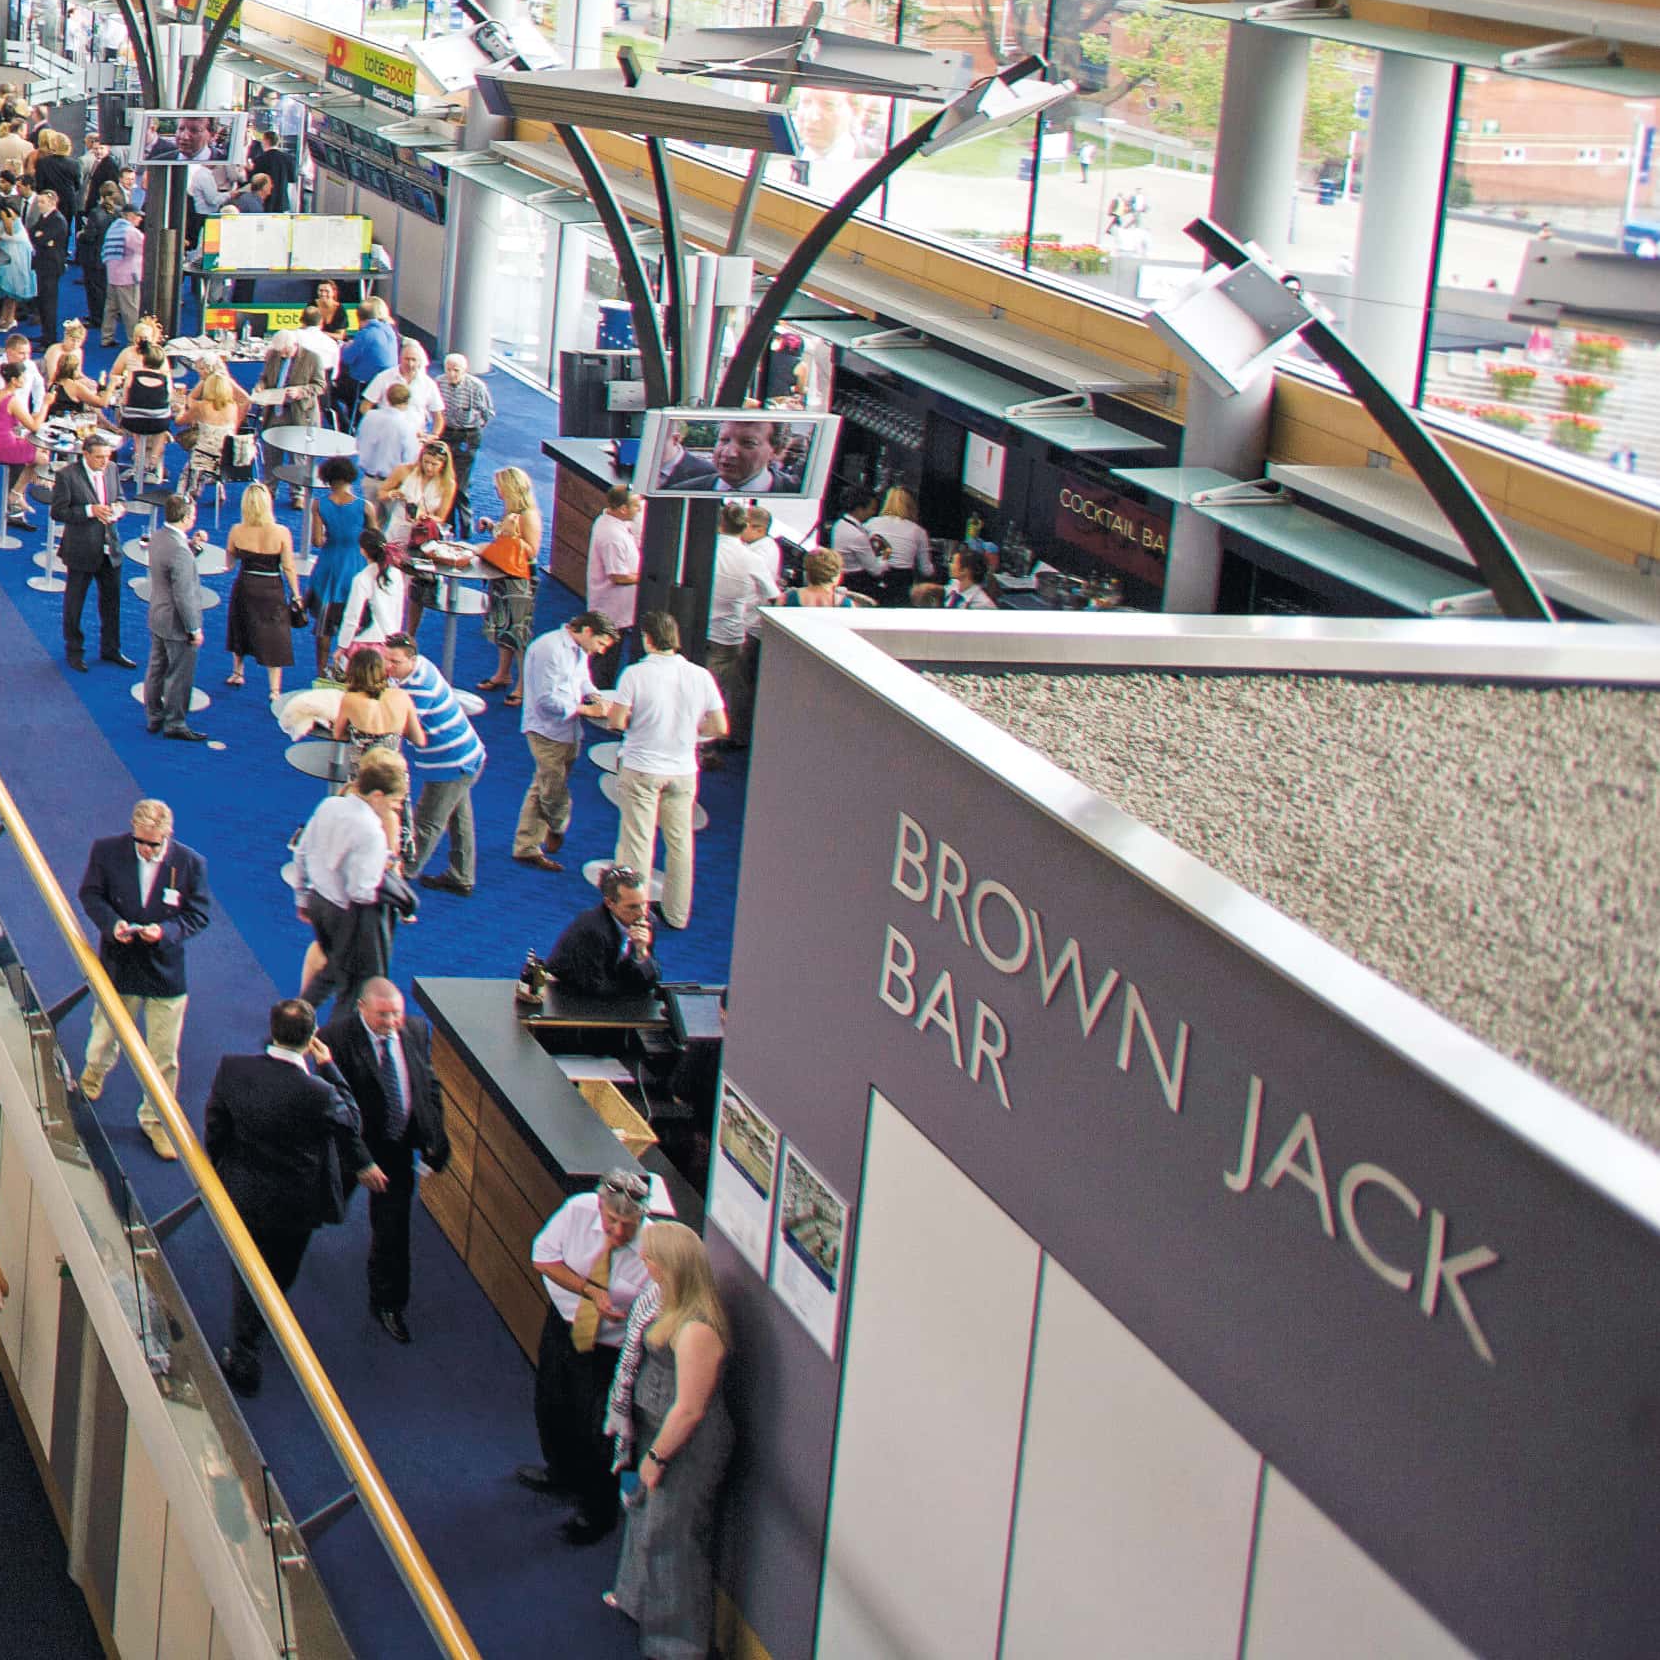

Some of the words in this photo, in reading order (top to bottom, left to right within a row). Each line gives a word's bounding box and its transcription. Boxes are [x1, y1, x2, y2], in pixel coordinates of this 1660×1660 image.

[363, 51, 413, 88] totesport
[1059, 488, 1139, 541] COCKTAIL
[1142, 526, 1166, 555] BA
[878, 924, 1012, 1111] BAR
[891, 811, 1189, 1113] BROWN
[1224, 1074, 1499, 1364] JACK
